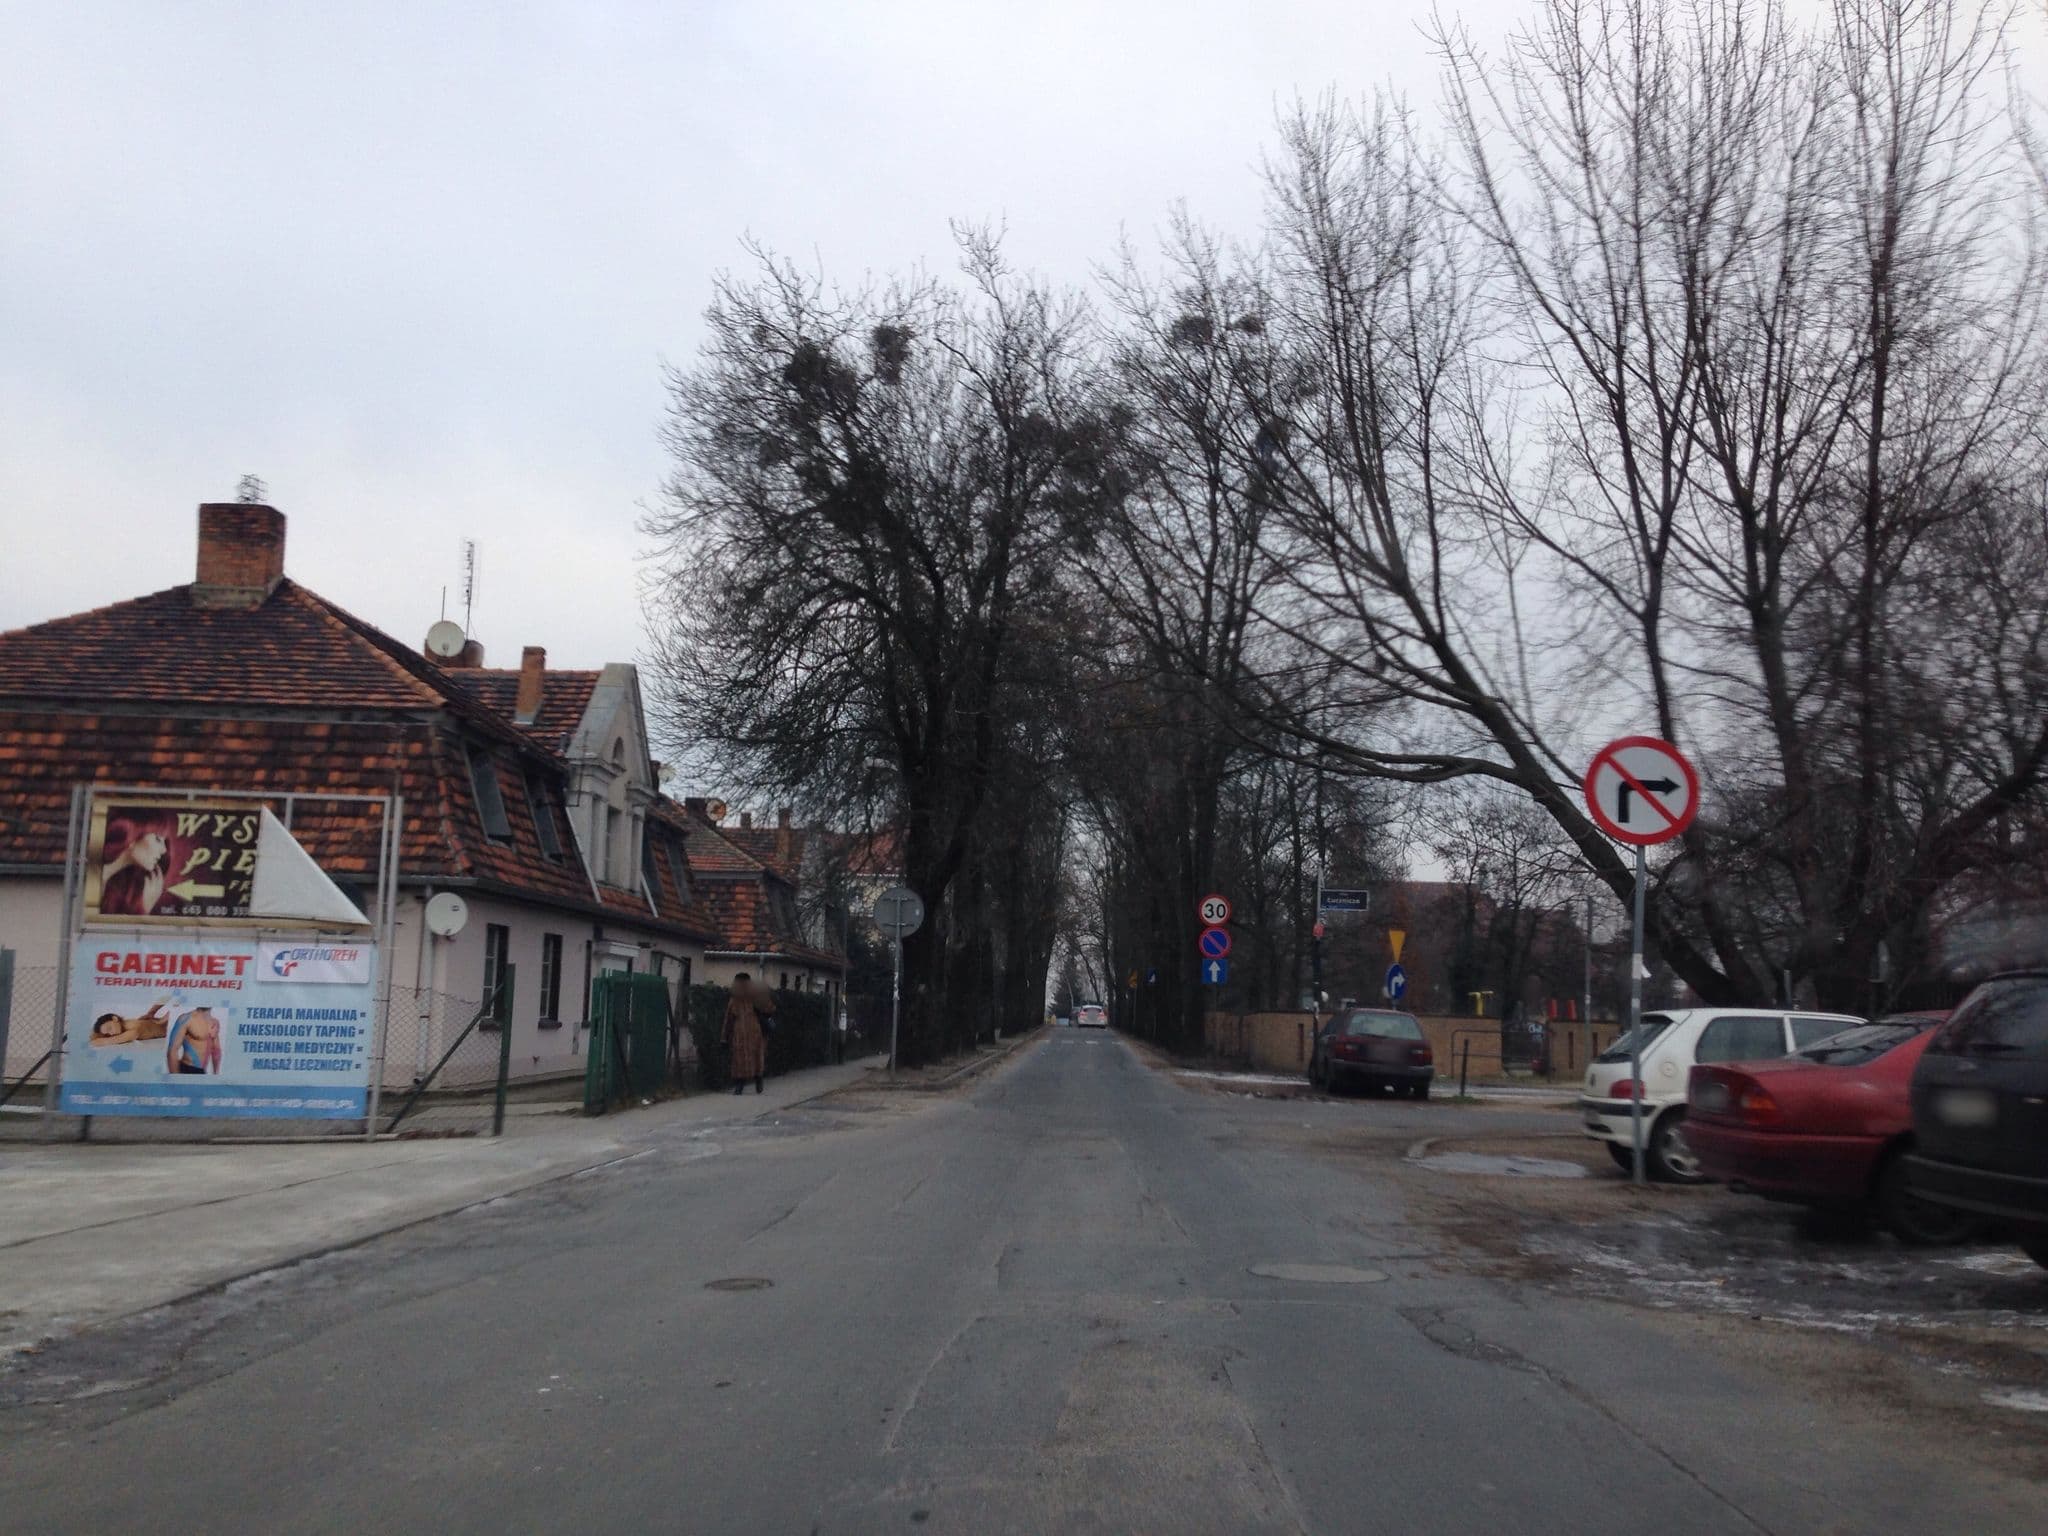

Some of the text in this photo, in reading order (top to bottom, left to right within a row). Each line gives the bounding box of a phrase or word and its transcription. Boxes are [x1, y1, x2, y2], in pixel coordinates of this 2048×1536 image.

[1204, 903, 1227, 919] 30
[95, 951, 253, 976] GABINET
[94, 976, 243, 990] TERAPII MANUALNEJ
[246, 1007, 357, 1021] TERAPIA MANUALNA
[237, 1023, 356, 1038] KINESIOLOGY TAPING
[242, 1041, 355, 1055] TRENING MEDYCZNY
[293, 1058, 353, 1072] LECZNICZY
